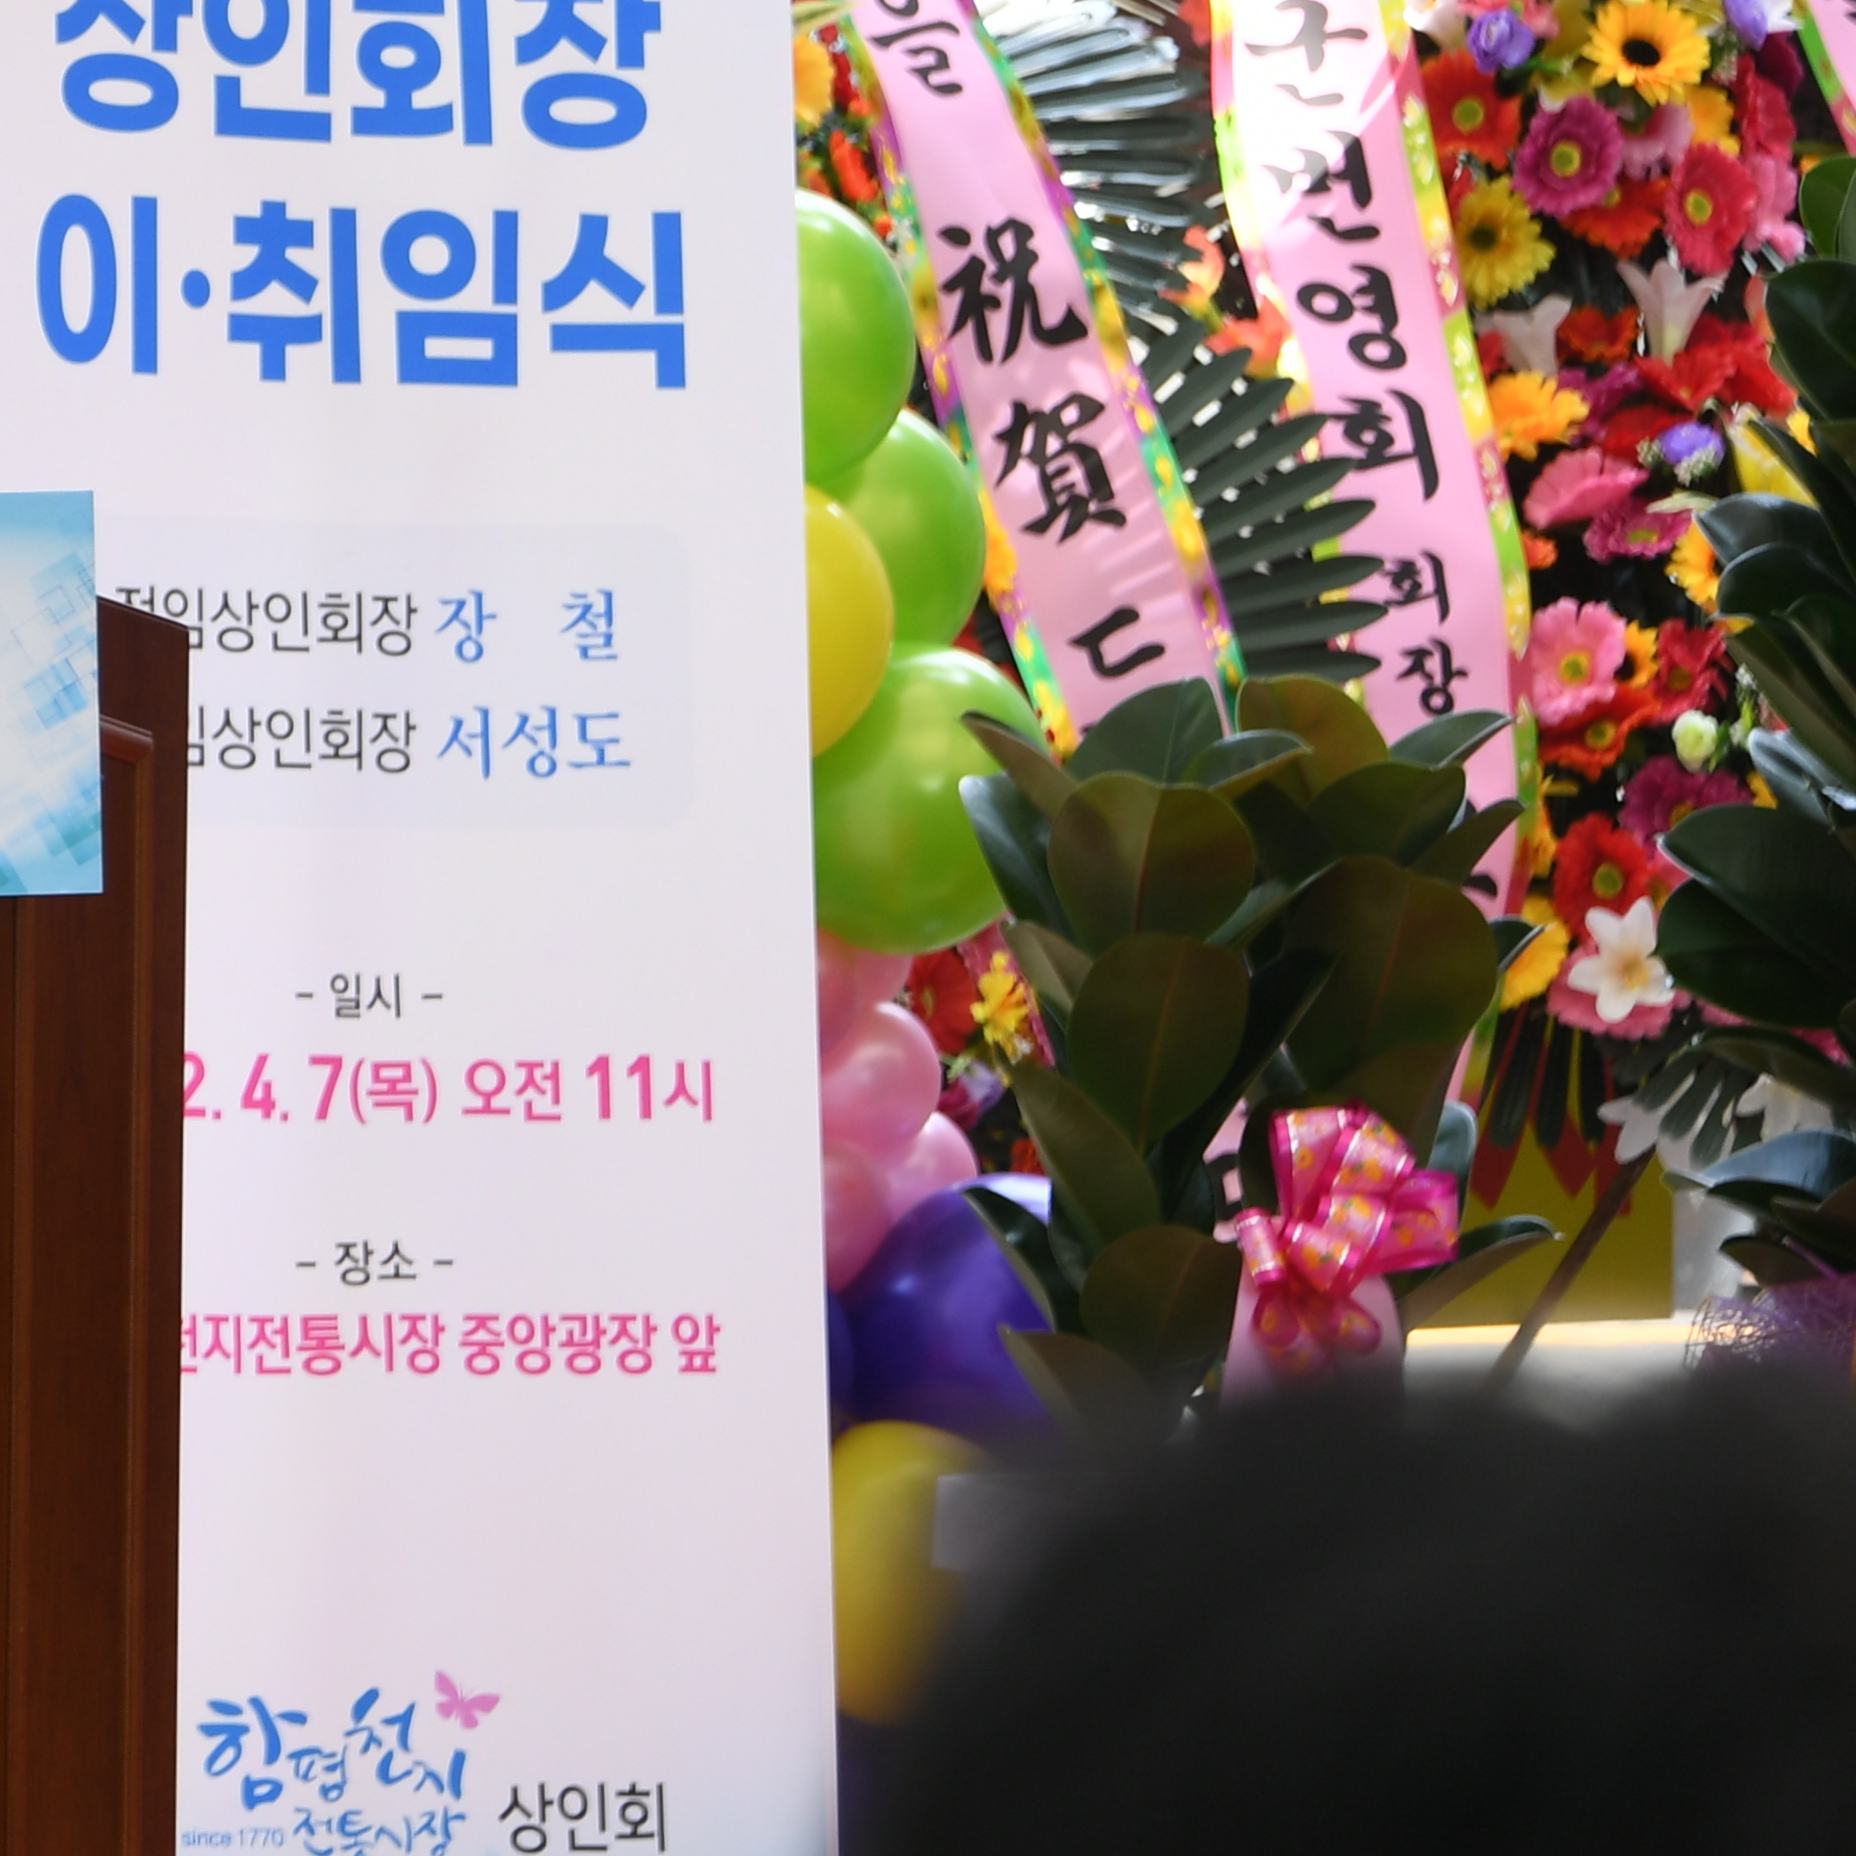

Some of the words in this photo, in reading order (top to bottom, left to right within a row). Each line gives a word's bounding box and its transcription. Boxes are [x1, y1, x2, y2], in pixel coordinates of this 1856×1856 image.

[36, 192, 688, 390] 이·취임식
[438, 704, 632, 781] 서성도
[461, 1058, 563, 1123] 오전
[585, 1054, 715, 1123] 11시
[459, 1312, 659, 1377] 중앙광장
[669, 1312, 723, 1375] 앞
[181, 1830, 232, 1848] since
[497, 1781, 668, 1855] 상인회
